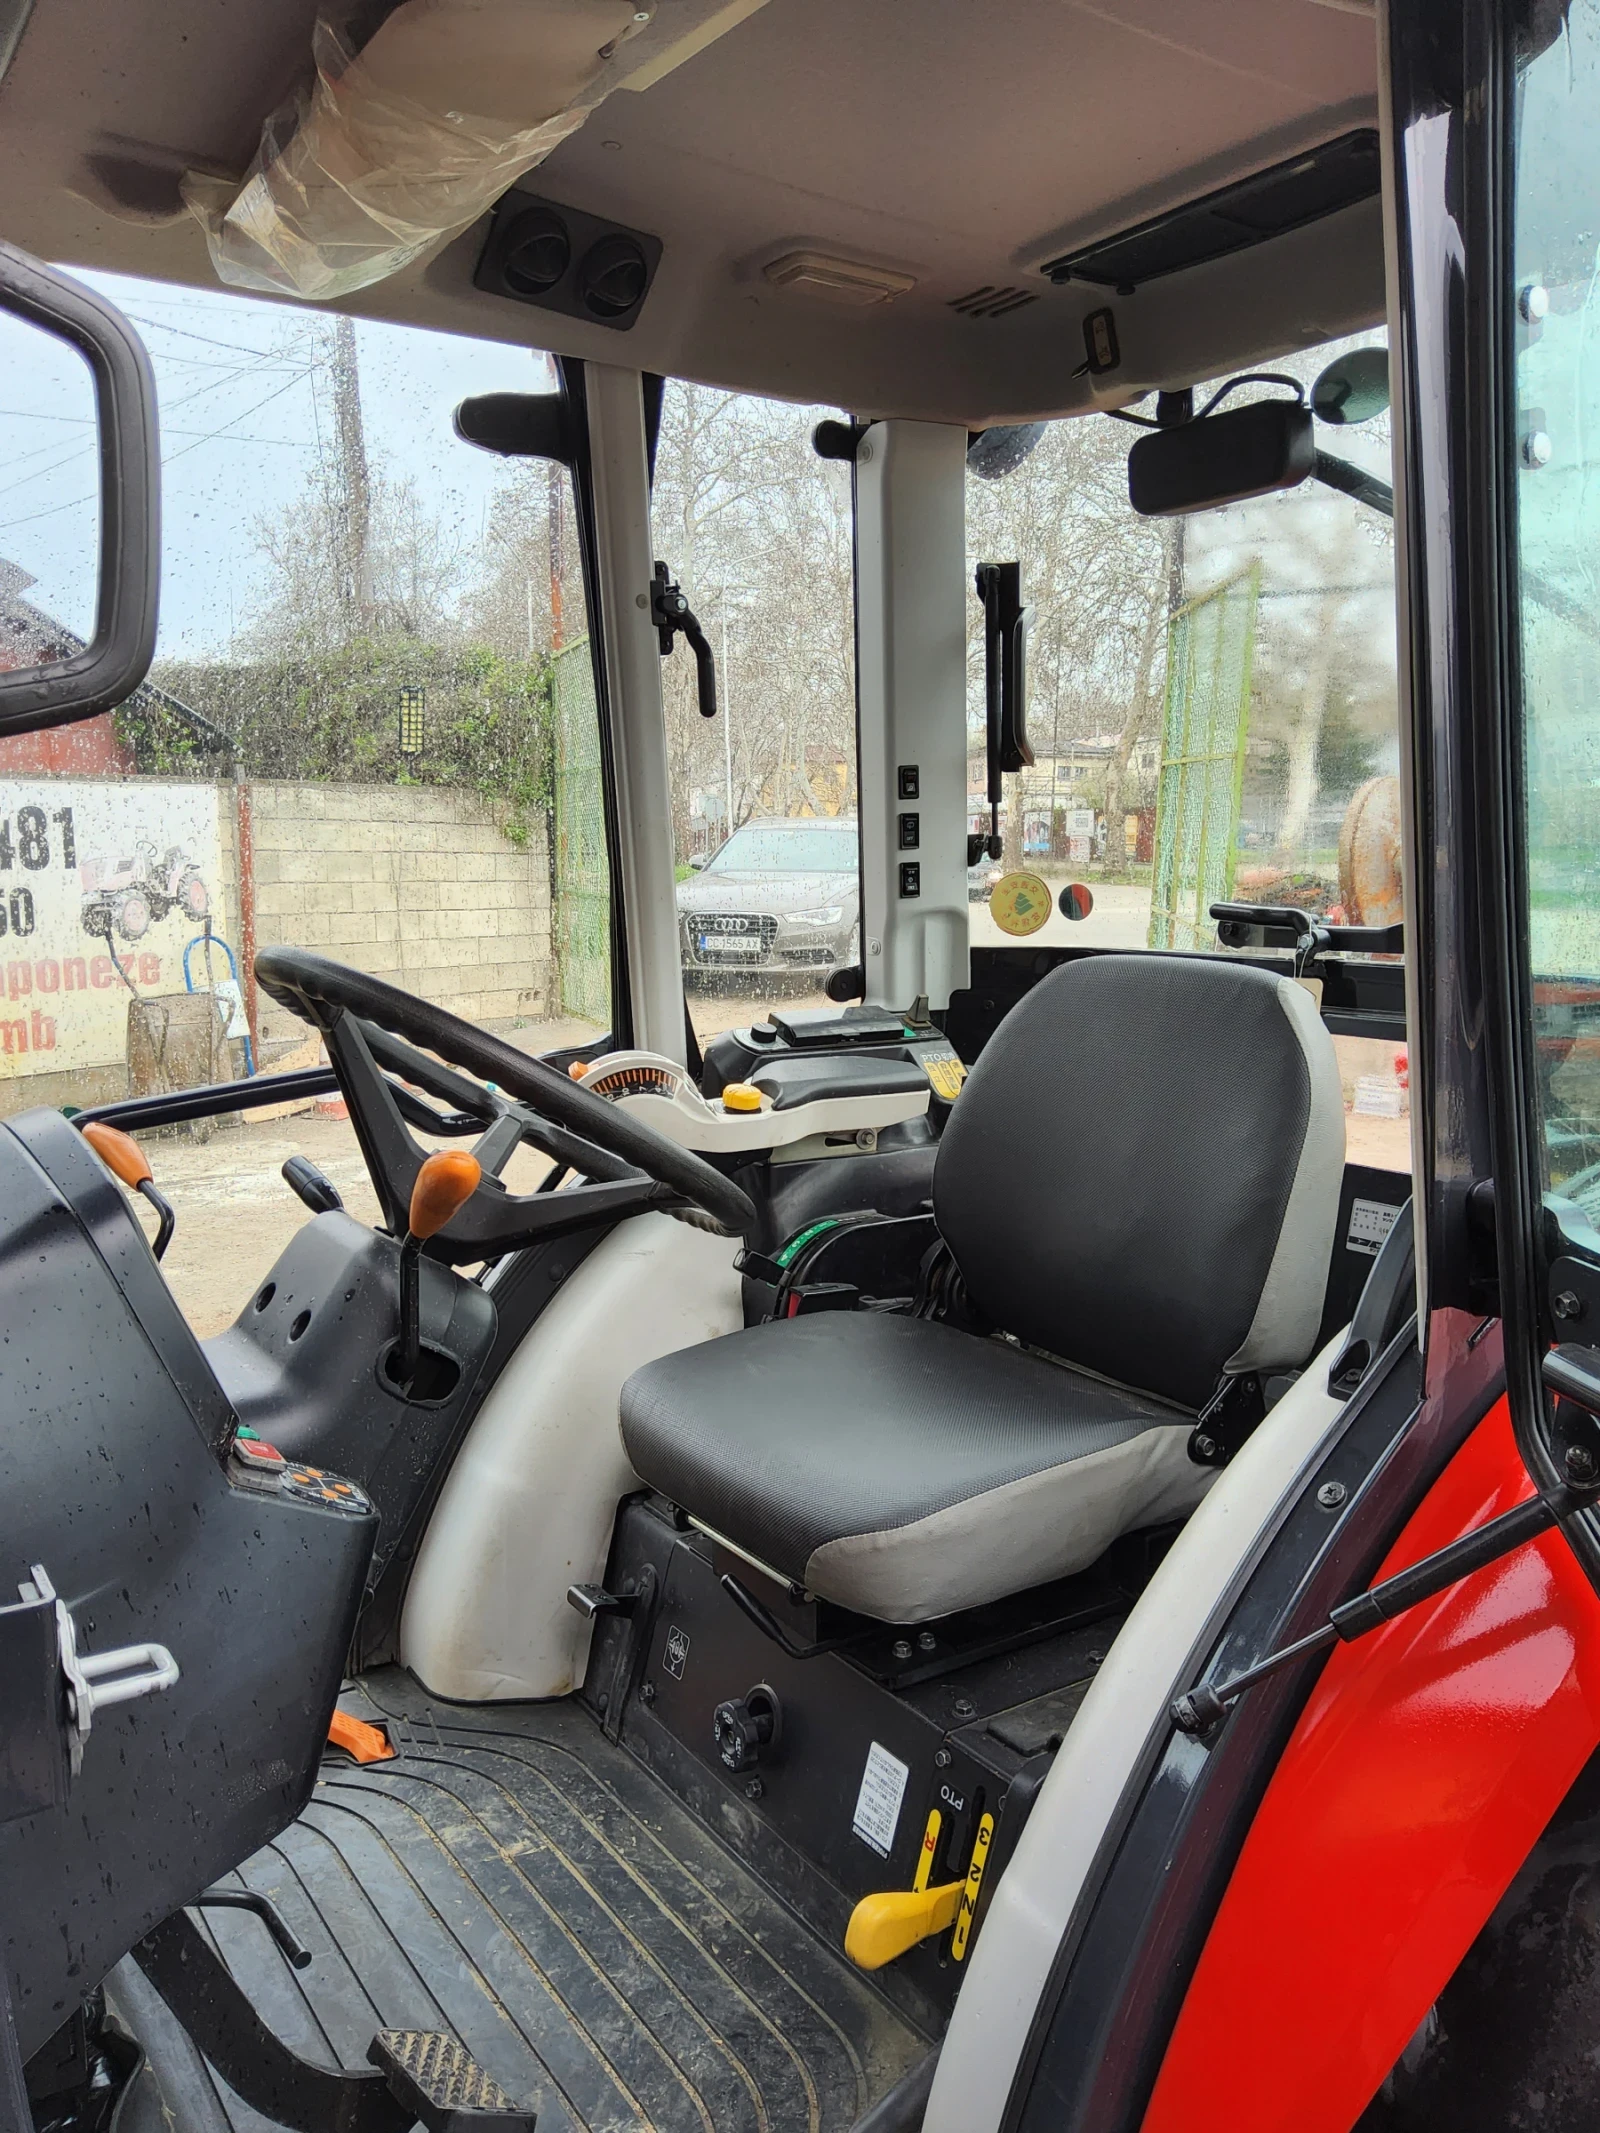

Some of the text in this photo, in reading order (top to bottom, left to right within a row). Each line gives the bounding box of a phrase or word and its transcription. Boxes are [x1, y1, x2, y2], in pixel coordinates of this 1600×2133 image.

[0, 952, 160, 1001] poneze
[940, 1785, 964, 1811] PTO
[924, 1832, 935, 1852] R
[958, 1827, 990, 1944] 1 N 2 3
